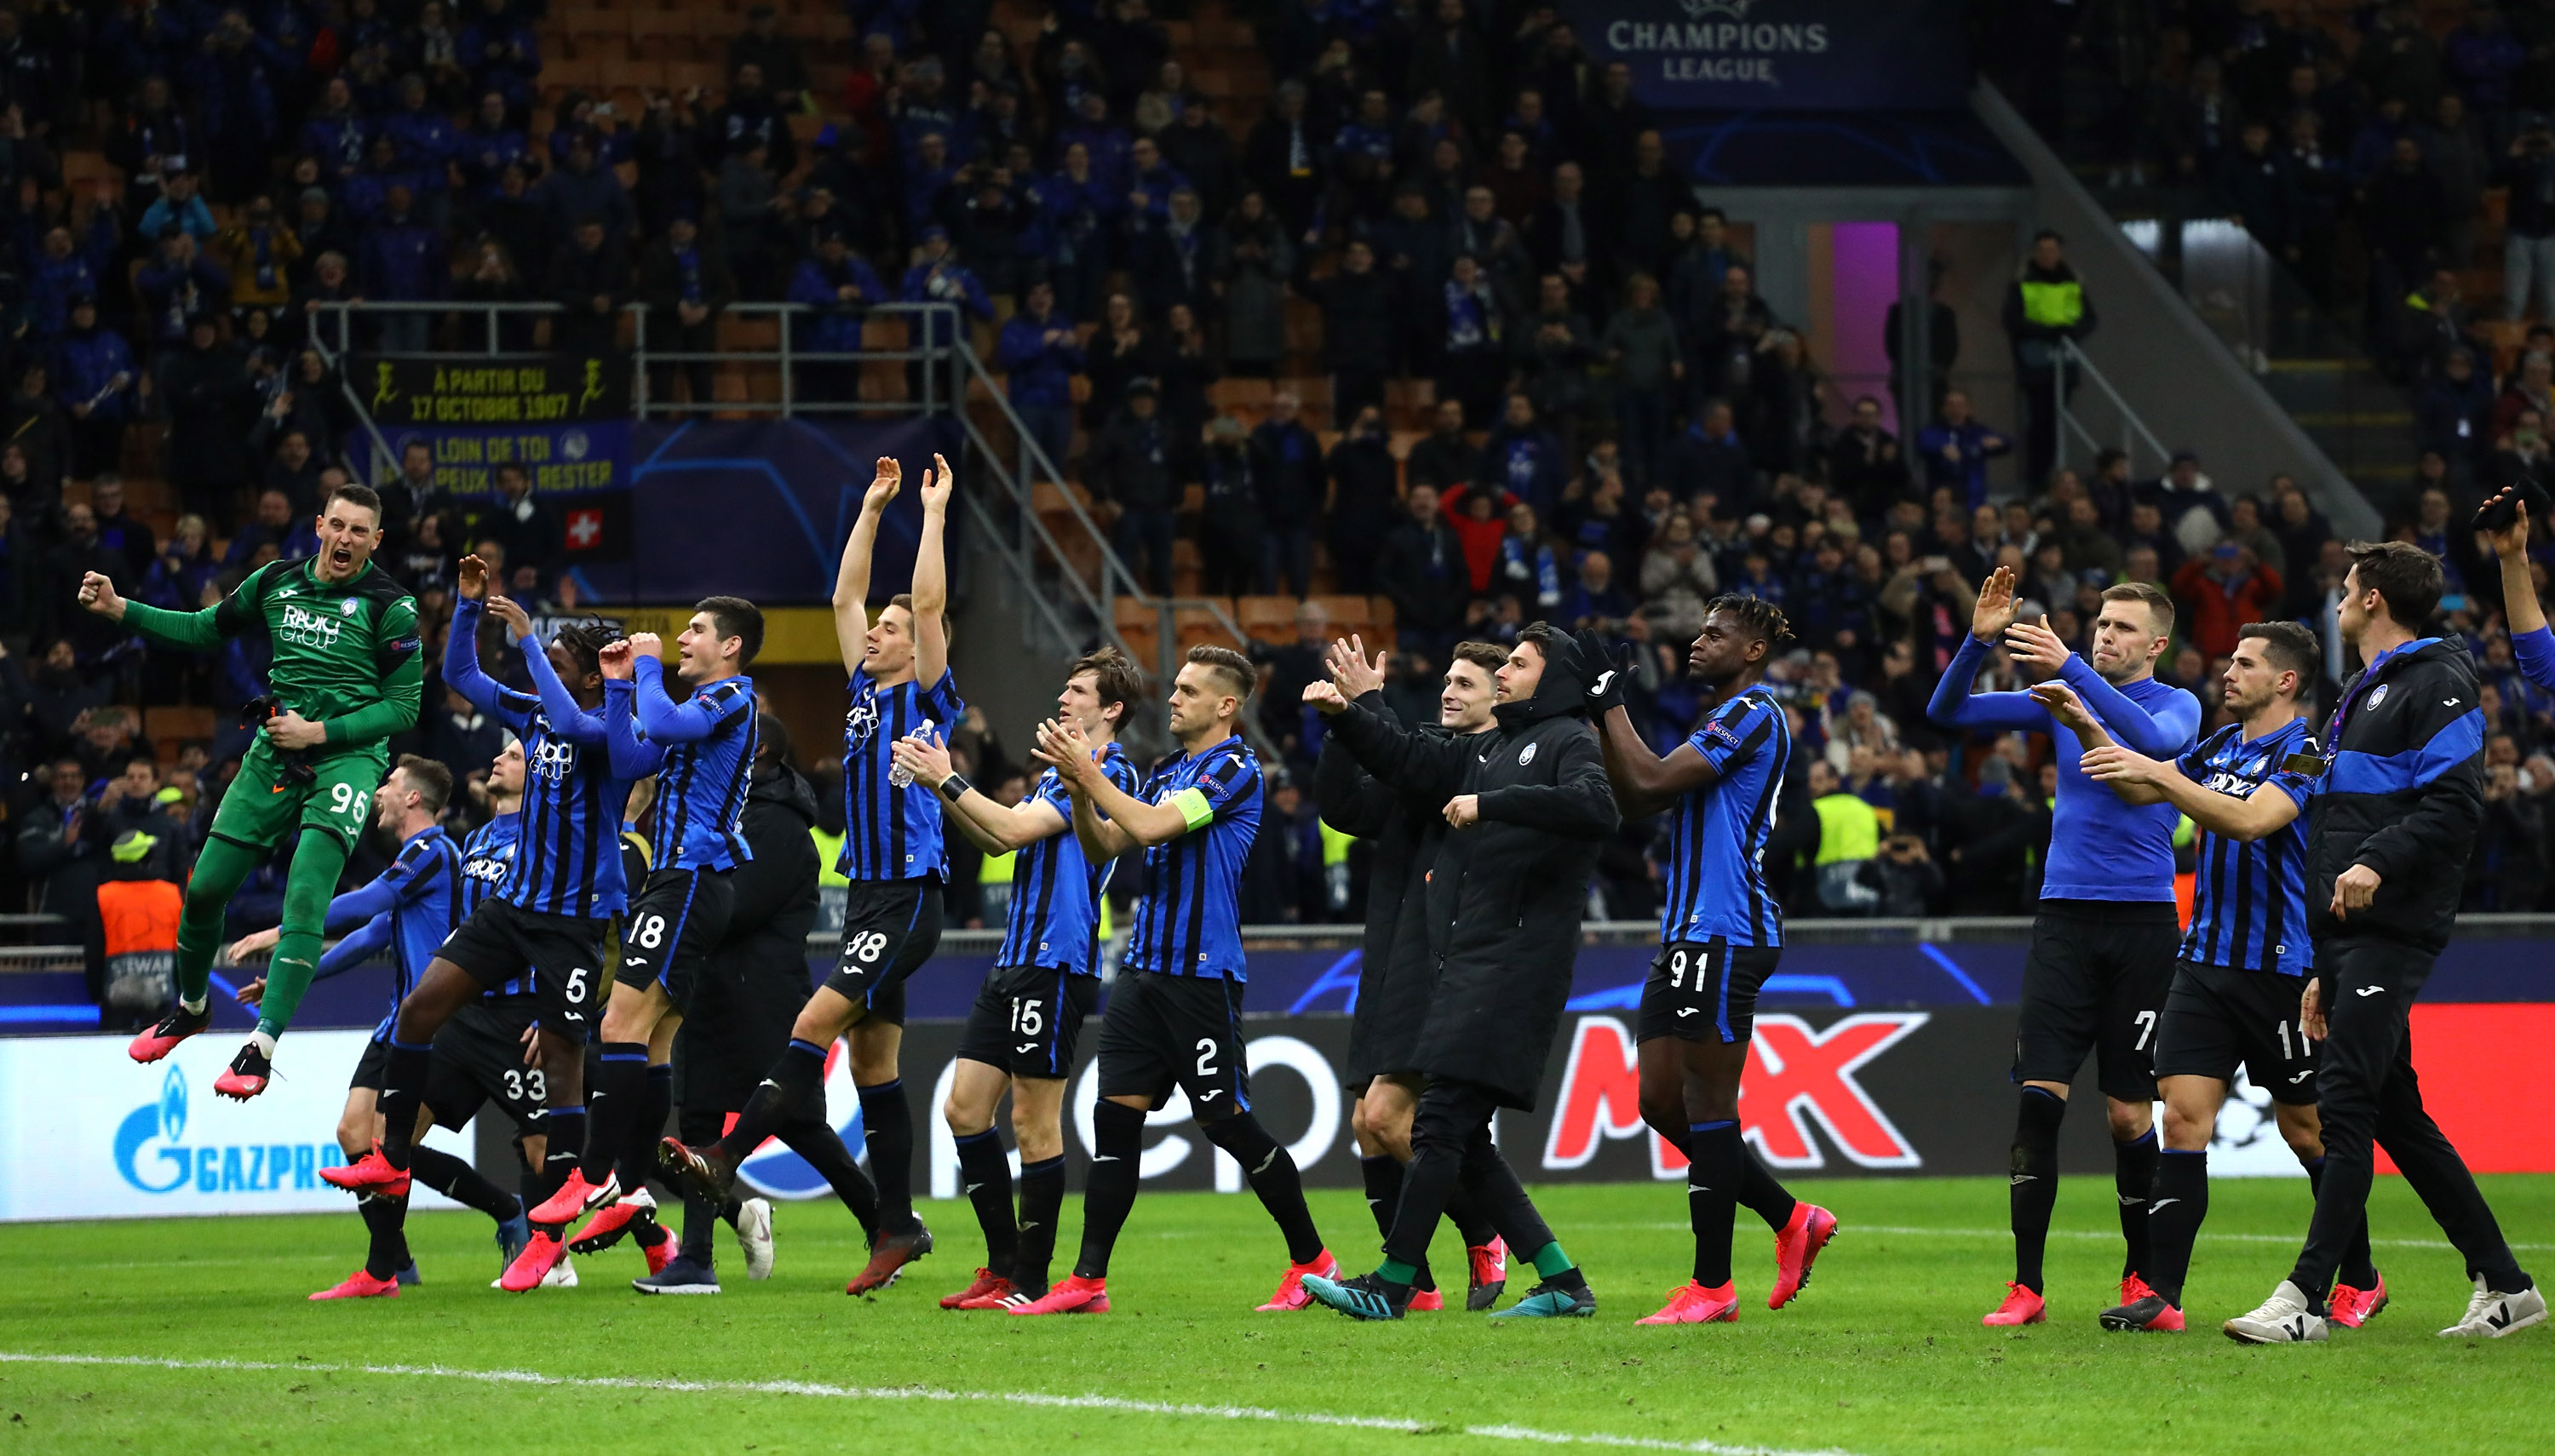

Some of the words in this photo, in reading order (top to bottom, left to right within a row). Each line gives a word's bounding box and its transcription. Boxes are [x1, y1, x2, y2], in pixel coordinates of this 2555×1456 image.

[1607, 19, 1829, 54] CHAMPIONS
[1662, 57, 1775, 82] LEAGUE
[449, 368, 516, 393] PARTIR
[519, 368, 546, 393] DU
[411, 394, 433, 421] 17
[435, 394, 520, 421] OCTOBRE
[525, 393, 570, 420] 1907
[435, 436, 483, 463] LOIN
[486, 436, 513, 462] DE
[517, 435, 551, 461] TOI
[435, 467, 489, 495] PEUX
[537, 460, 613, 491] RESTER
[279, 624, 337, 650] GROUP
[703, 695, 726, 716] RESPECT
[1714, 725, 1739, 745] RESPECT
[330, 782, 368, 823] 95
[1207, 778, 1231, 798] RESPECT
[628, 911, 666, 949] 18
[566, 968, 588, 1004] 5
[1670, 951, 1708, 993] 91
[1011, 996, 1043, 1036] 15
[1196, 1038, 1218, 1076] 2
[503, 1069, 547, 1101] 33
[1542, 1012, 1932, 1181] MAX
[196, 1144, 345, 1194] GAZPRO
